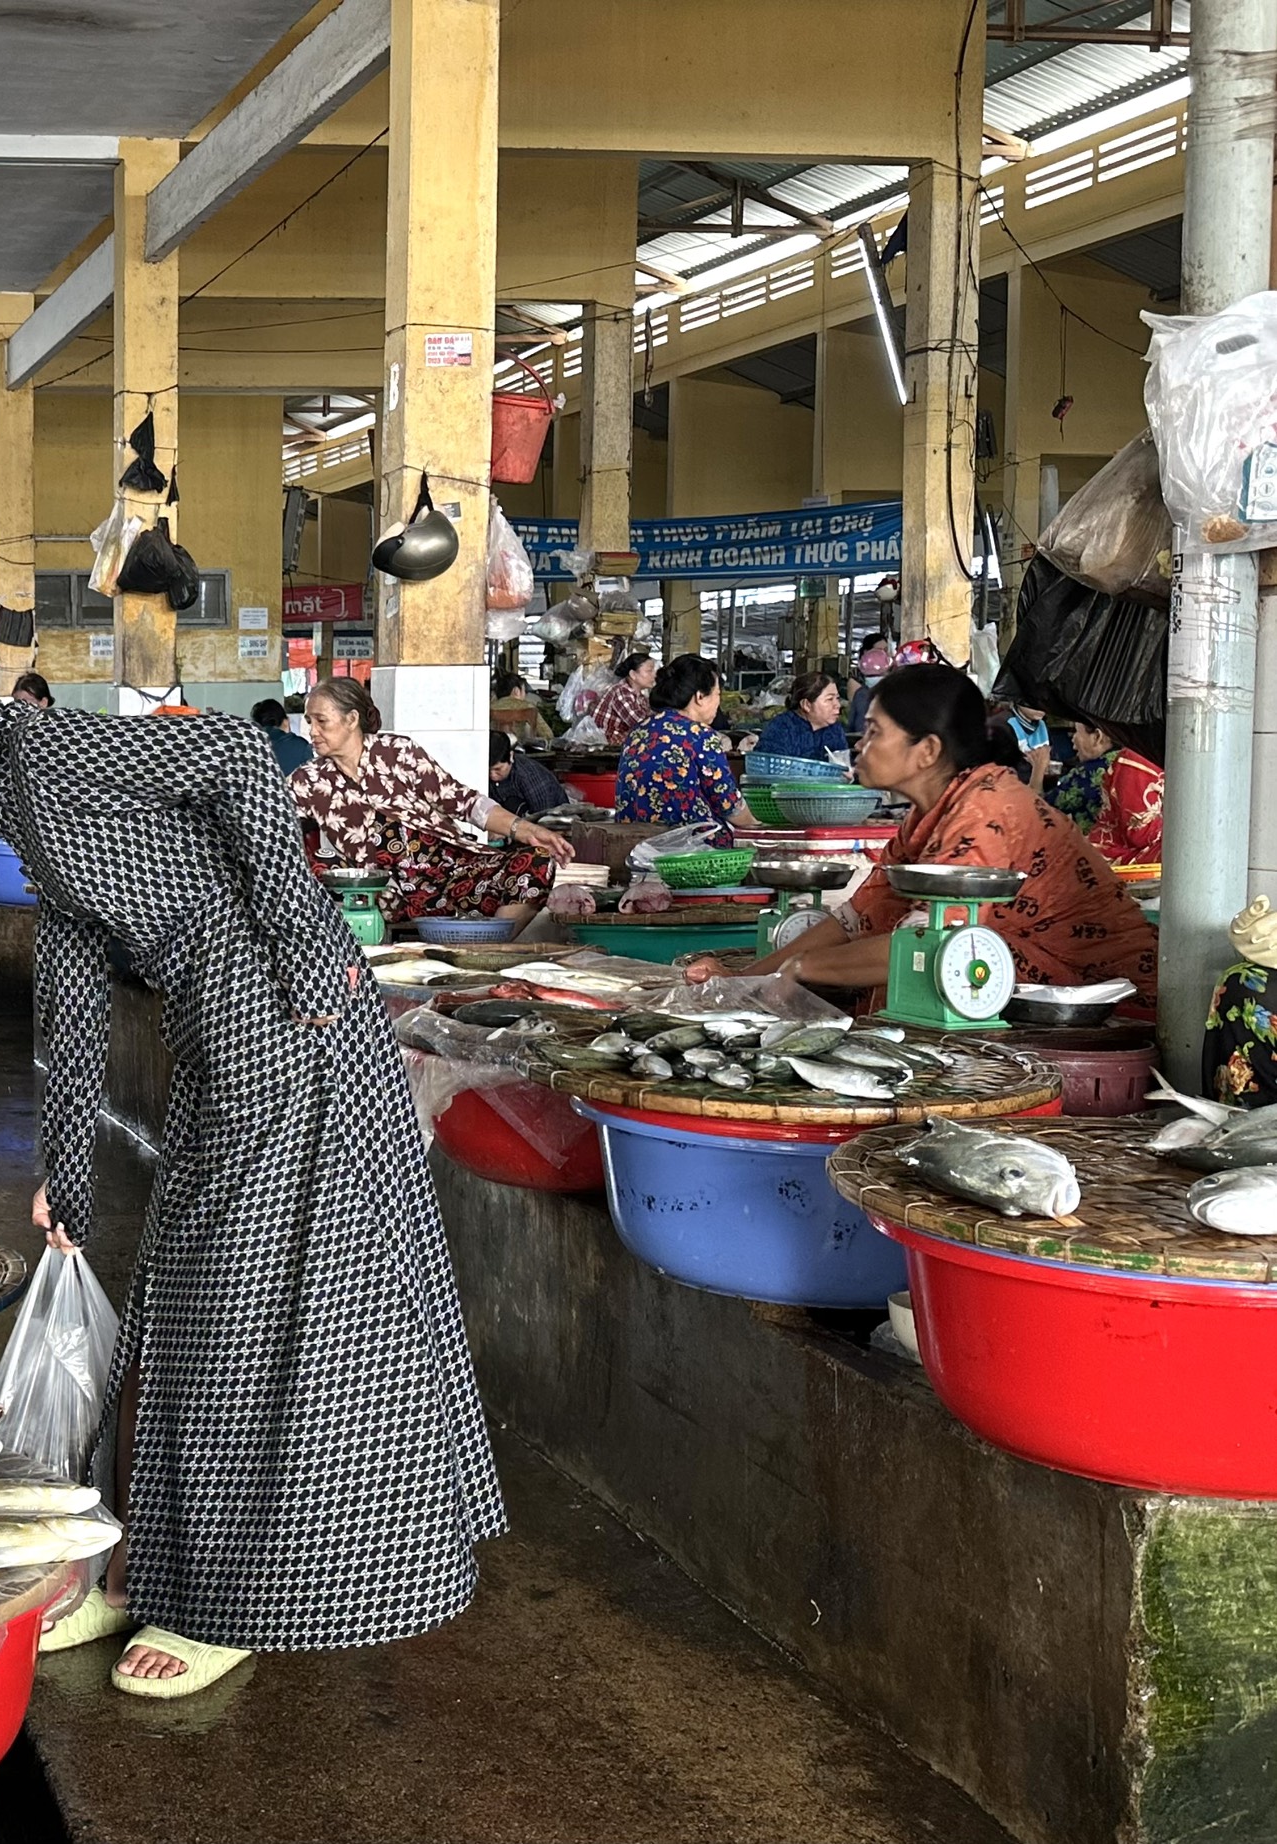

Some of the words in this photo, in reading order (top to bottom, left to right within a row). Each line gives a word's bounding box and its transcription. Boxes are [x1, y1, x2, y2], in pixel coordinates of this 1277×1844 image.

[652, 524, 709, 546] THỰC
[714, 517, 781, 540] PHẨM
[788, 518, 823, 540] TẠI
[829, 512, 874, 537] CHỢ
[648, 549, 703, 569] KINH
[709, 545, 786, 567] DOANH
[793, 540, 849, 567] THỰC
[855, 531, 903, 562] PHẨ
[285, 596, 323, 617] mặt
[1076, 856, 1099, 890] C&K
[1069, 925, 1107, 939] C&K
